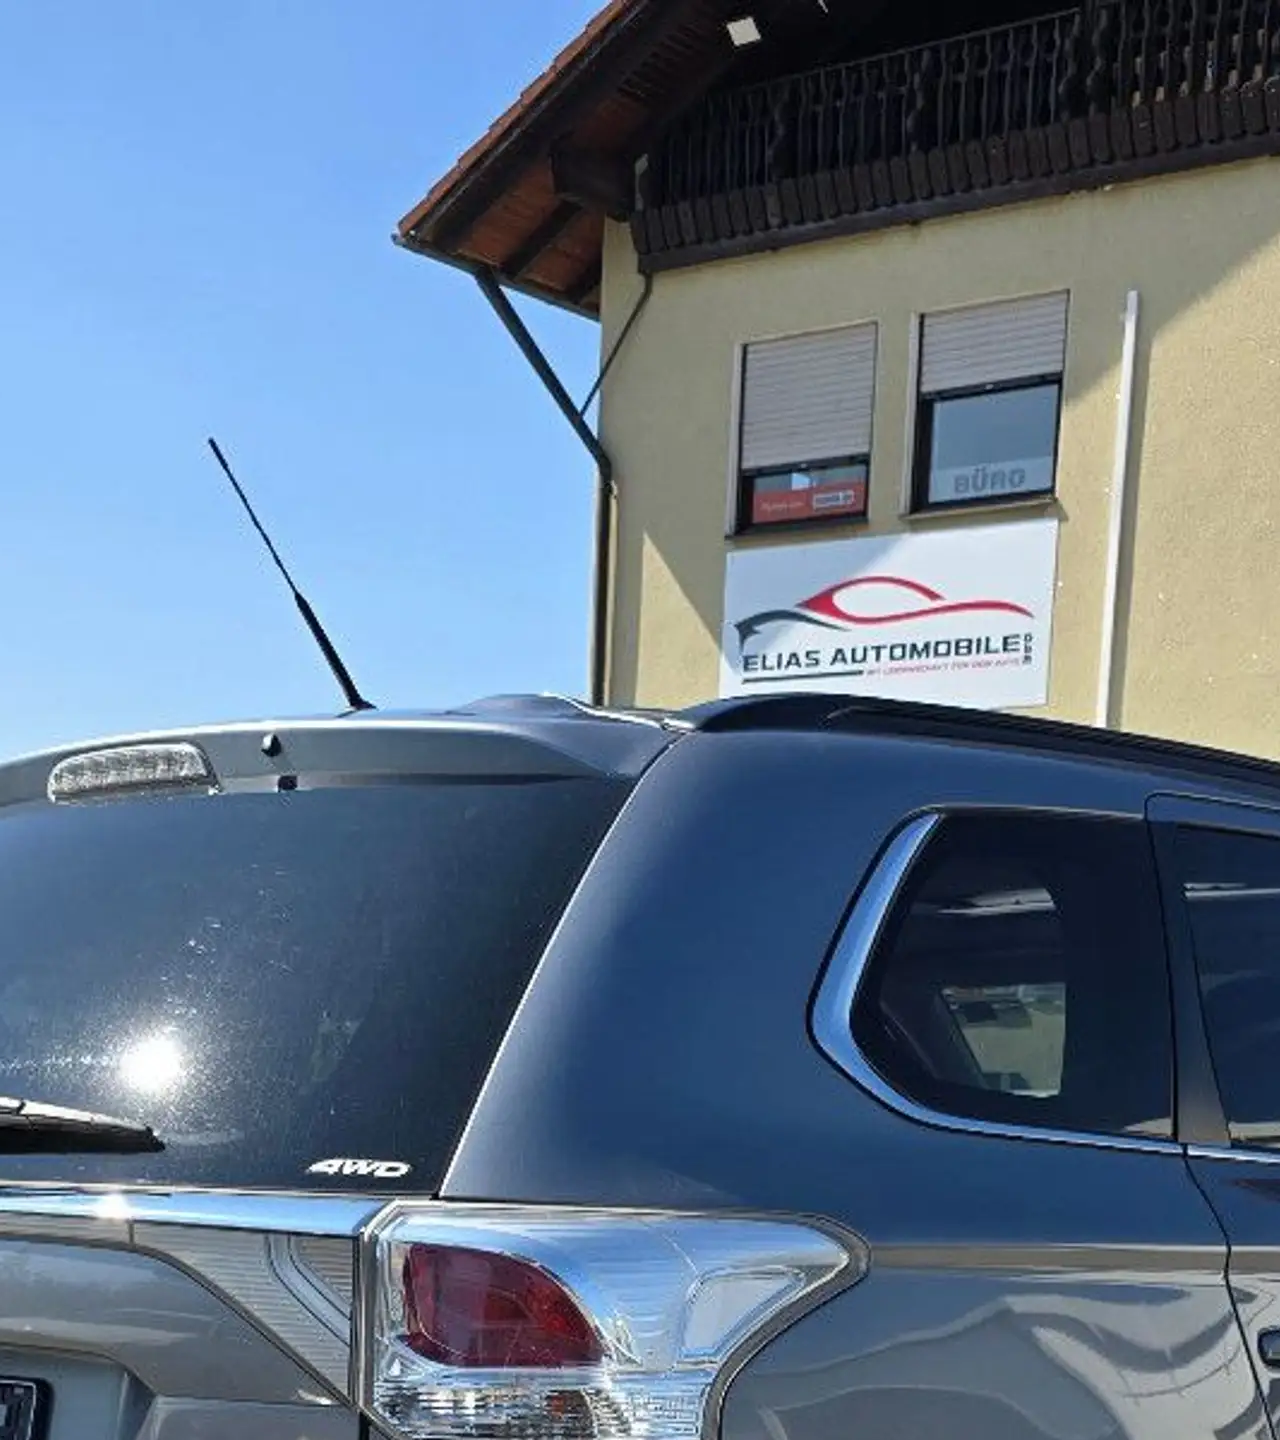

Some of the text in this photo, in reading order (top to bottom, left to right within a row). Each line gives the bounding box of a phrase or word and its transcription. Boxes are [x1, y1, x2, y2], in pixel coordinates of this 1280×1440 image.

[742, 650, 821, 672] ELIAS
[830, 634, 1021, 666] AUTOMOBILE
[305, 1159, 412, 1178] 4WD
